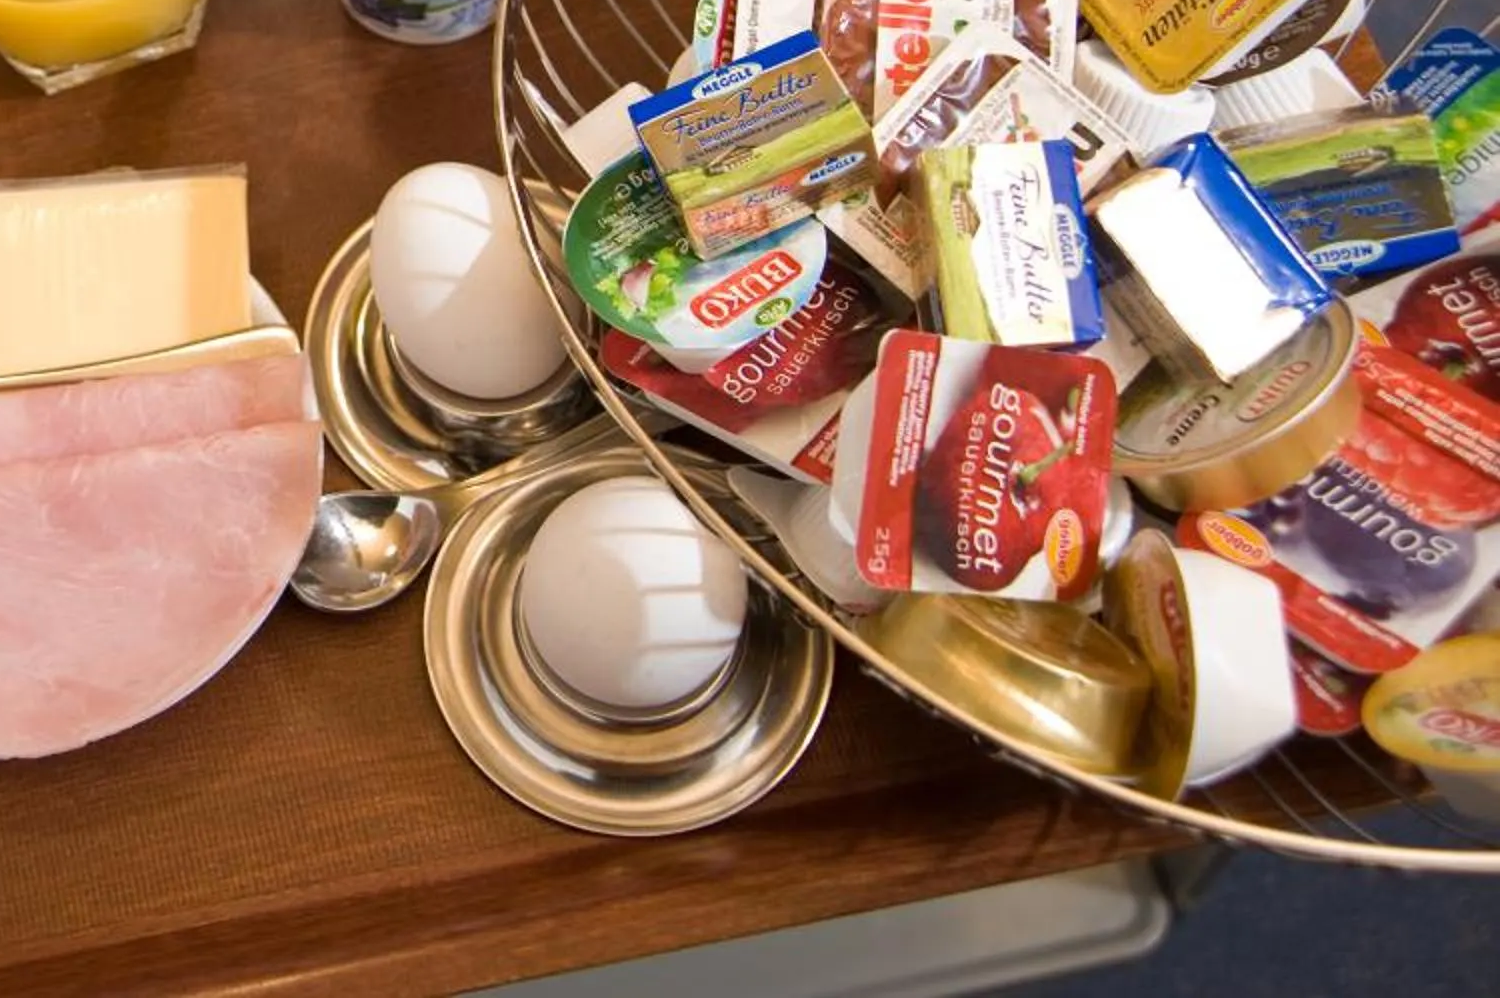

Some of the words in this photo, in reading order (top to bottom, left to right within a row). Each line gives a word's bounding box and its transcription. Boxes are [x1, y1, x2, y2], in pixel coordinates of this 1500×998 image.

[701, 66, 754, 97] MEGGLE
[733, 69, 818, 117] Butter
[809, 152, 859, 184] MEGGLE
[1056, 212, 1078, 270] MEGGLE
[1313, 243, 1375, 265] MEGGLE
[700, 254, 798, 325] BUKO
[1012, 230, 1053, 325] Butter
[767, 285, 860, 397] sauerkirsch
[1166, 394, 1221, 446] Creme
[956, 411, 987, 571] sauerkirsch
[974, 382, 1022, 575] gourmet
[867, 526, 892, 575] 25g
